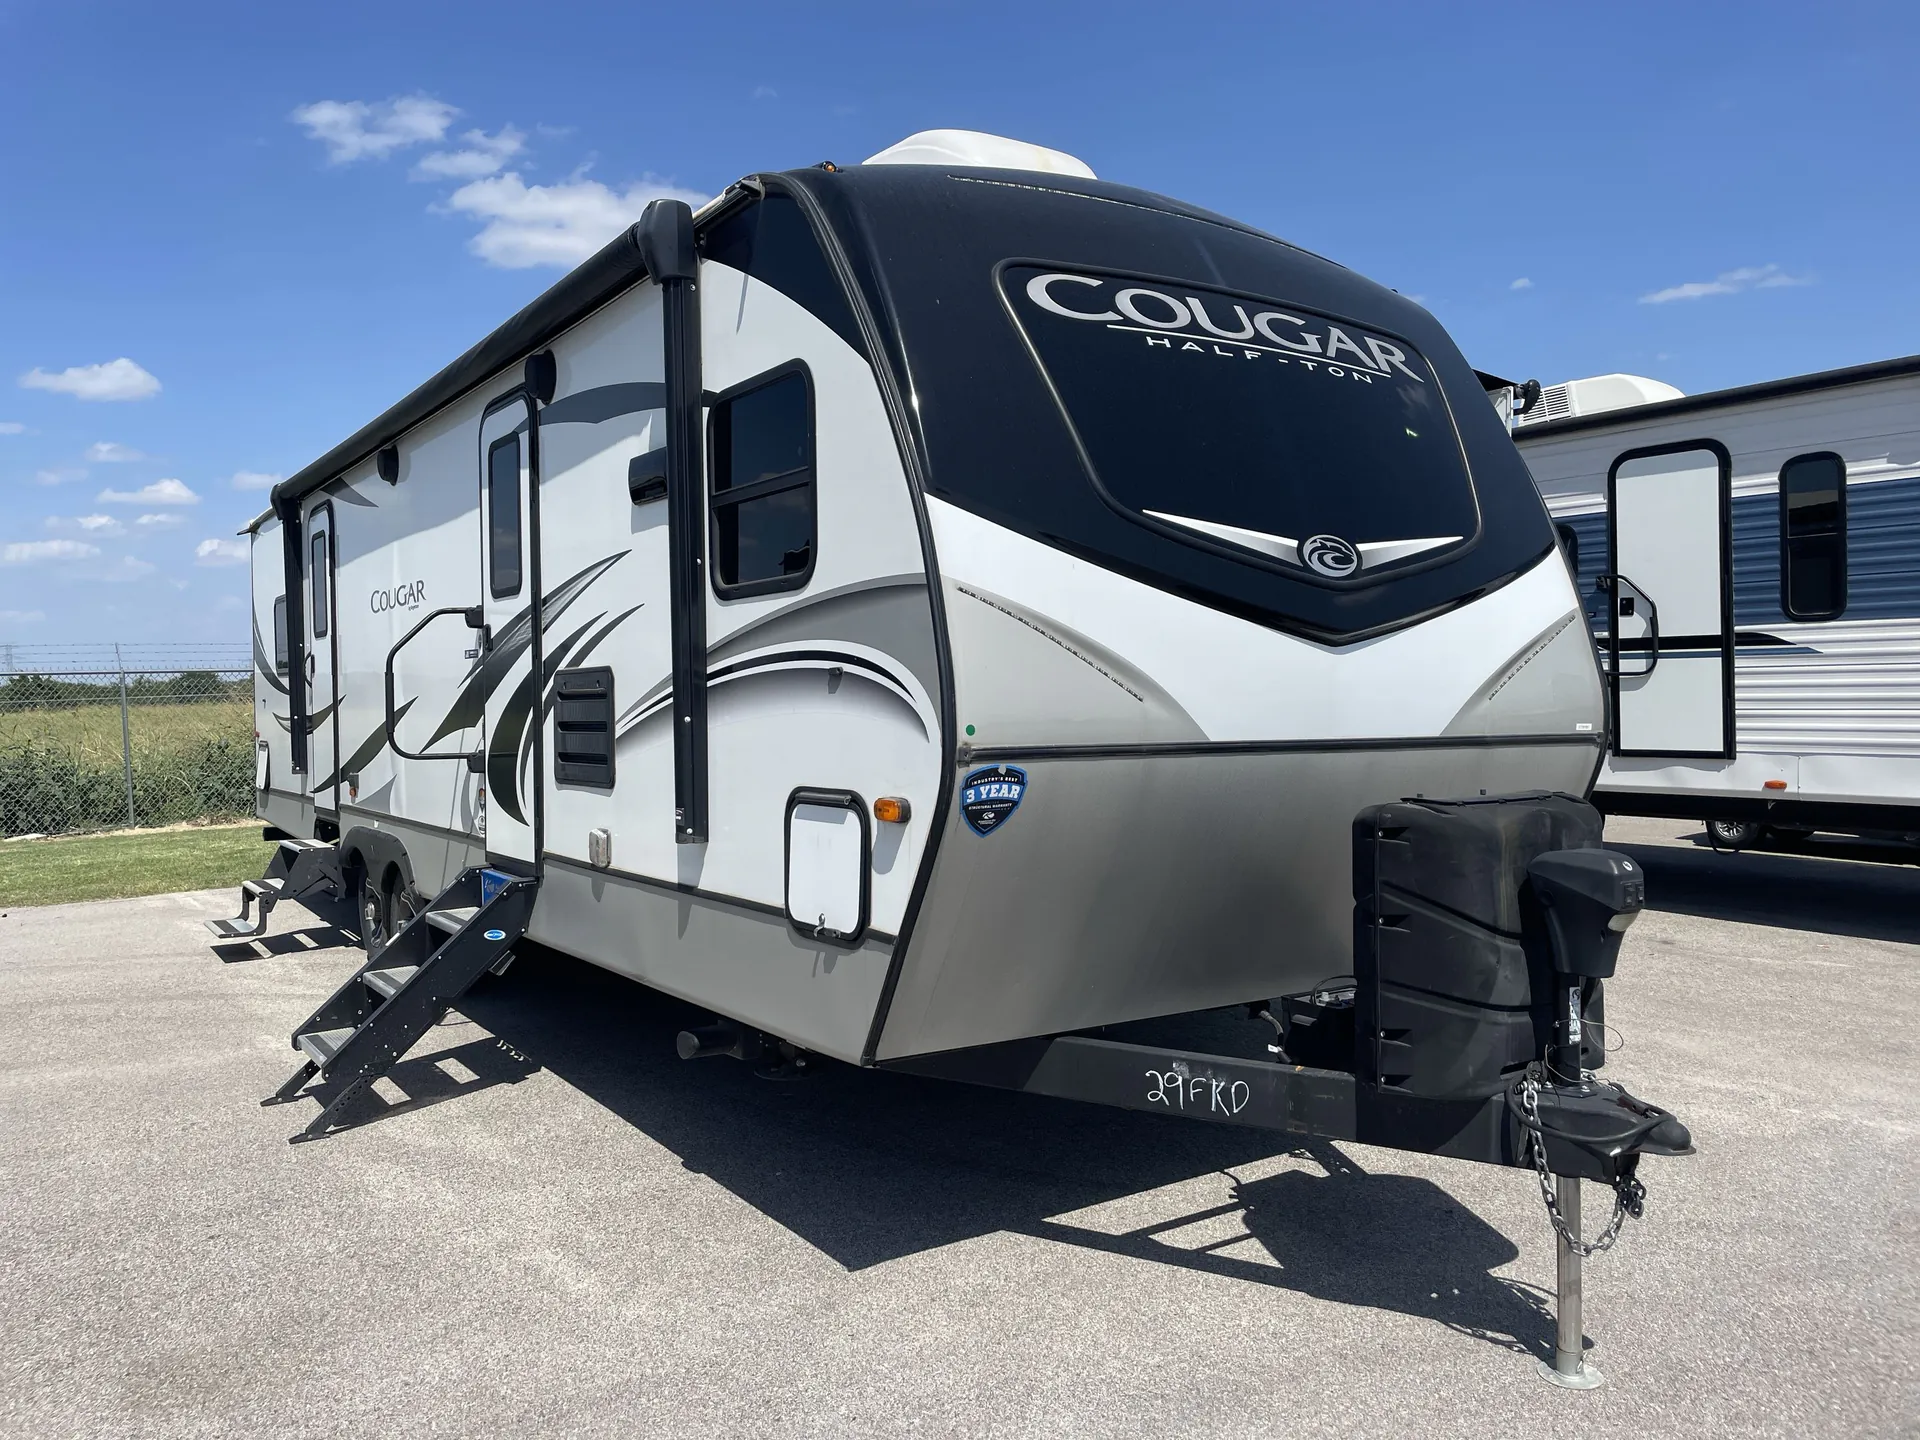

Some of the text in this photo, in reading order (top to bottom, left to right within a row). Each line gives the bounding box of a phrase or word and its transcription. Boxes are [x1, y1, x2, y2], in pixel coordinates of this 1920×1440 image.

[1026, 273, 1424, 383] COUGAR
[1146, 336, 1373, 384] HALF-TON
[371, 580, 426, 614] COUGAR
[966, 784, 1021, 803] 3 YEAR
